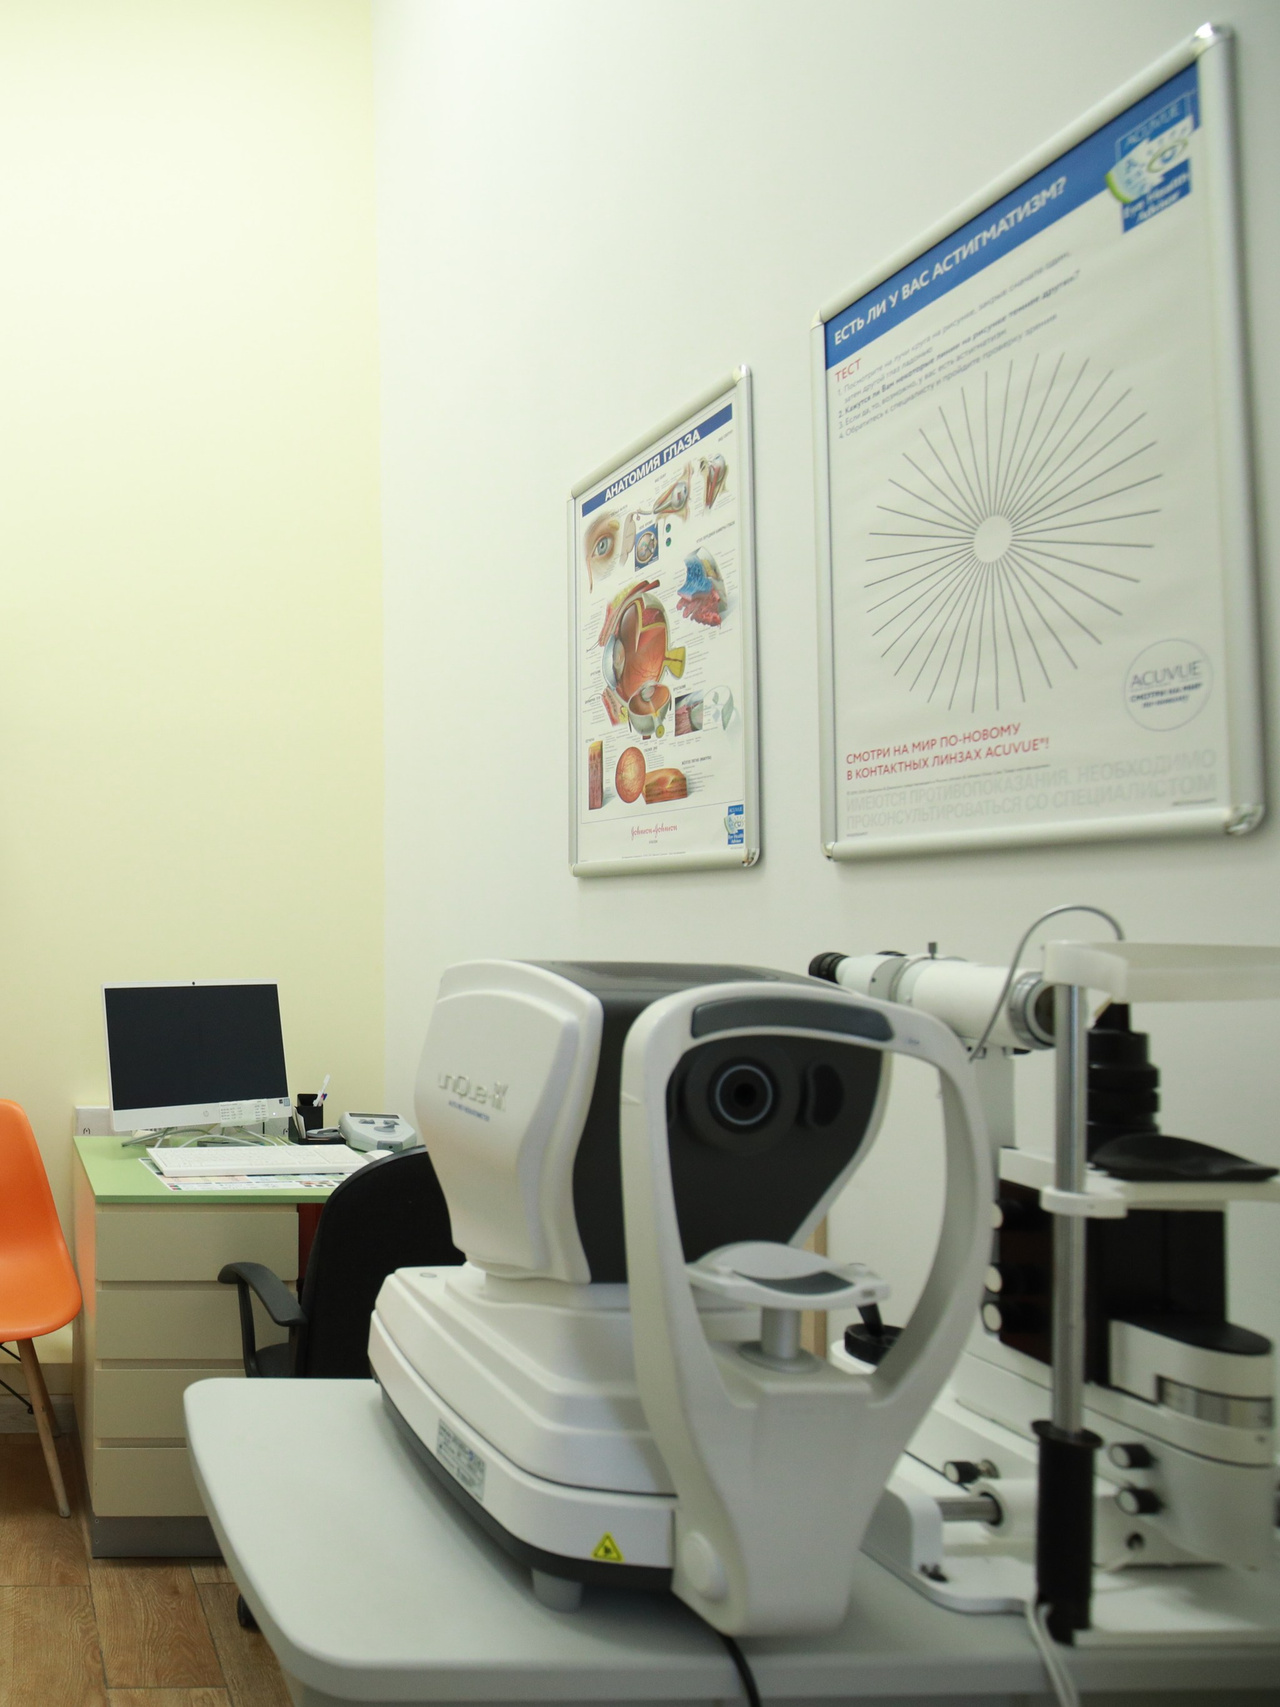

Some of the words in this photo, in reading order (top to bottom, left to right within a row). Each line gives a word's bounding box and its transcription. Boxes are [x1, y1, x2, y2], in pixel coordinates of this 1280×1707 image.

[834, 318, 864, 345] ЕСТЬ
[867, 300, 886, 324] ЛИ
[889, 290, 898, 308] У
[902, 270, 930, 300] ВАС
[932, 176, 1067, 280] АСТИГМАТИЗМ?
[835, 358, 861, 382] ТЕСТ
[604, 454, 661, 501] АНАТОМИЯ
[663, 429, 701, 463] ГЛАЗА
[1131, 660, 1202, 688] ACUVUE
[846, 747, 891, 765] СМОТРИ
[893, 743, 909, 757] НА
[912, 737, 937, 753] МИР
[940, 723, 1021, 748] ПО-НОВОМУ
[846, 770, 853, 781] В
[855, 756, 930, 779] КОНТАКТНЫХ
[932, 748, 983, 767] ЛИНЗАХ
[846, 790, 905, 812] ИМЕЮТСЯ
[1025, 793, 1048, 812] СО
